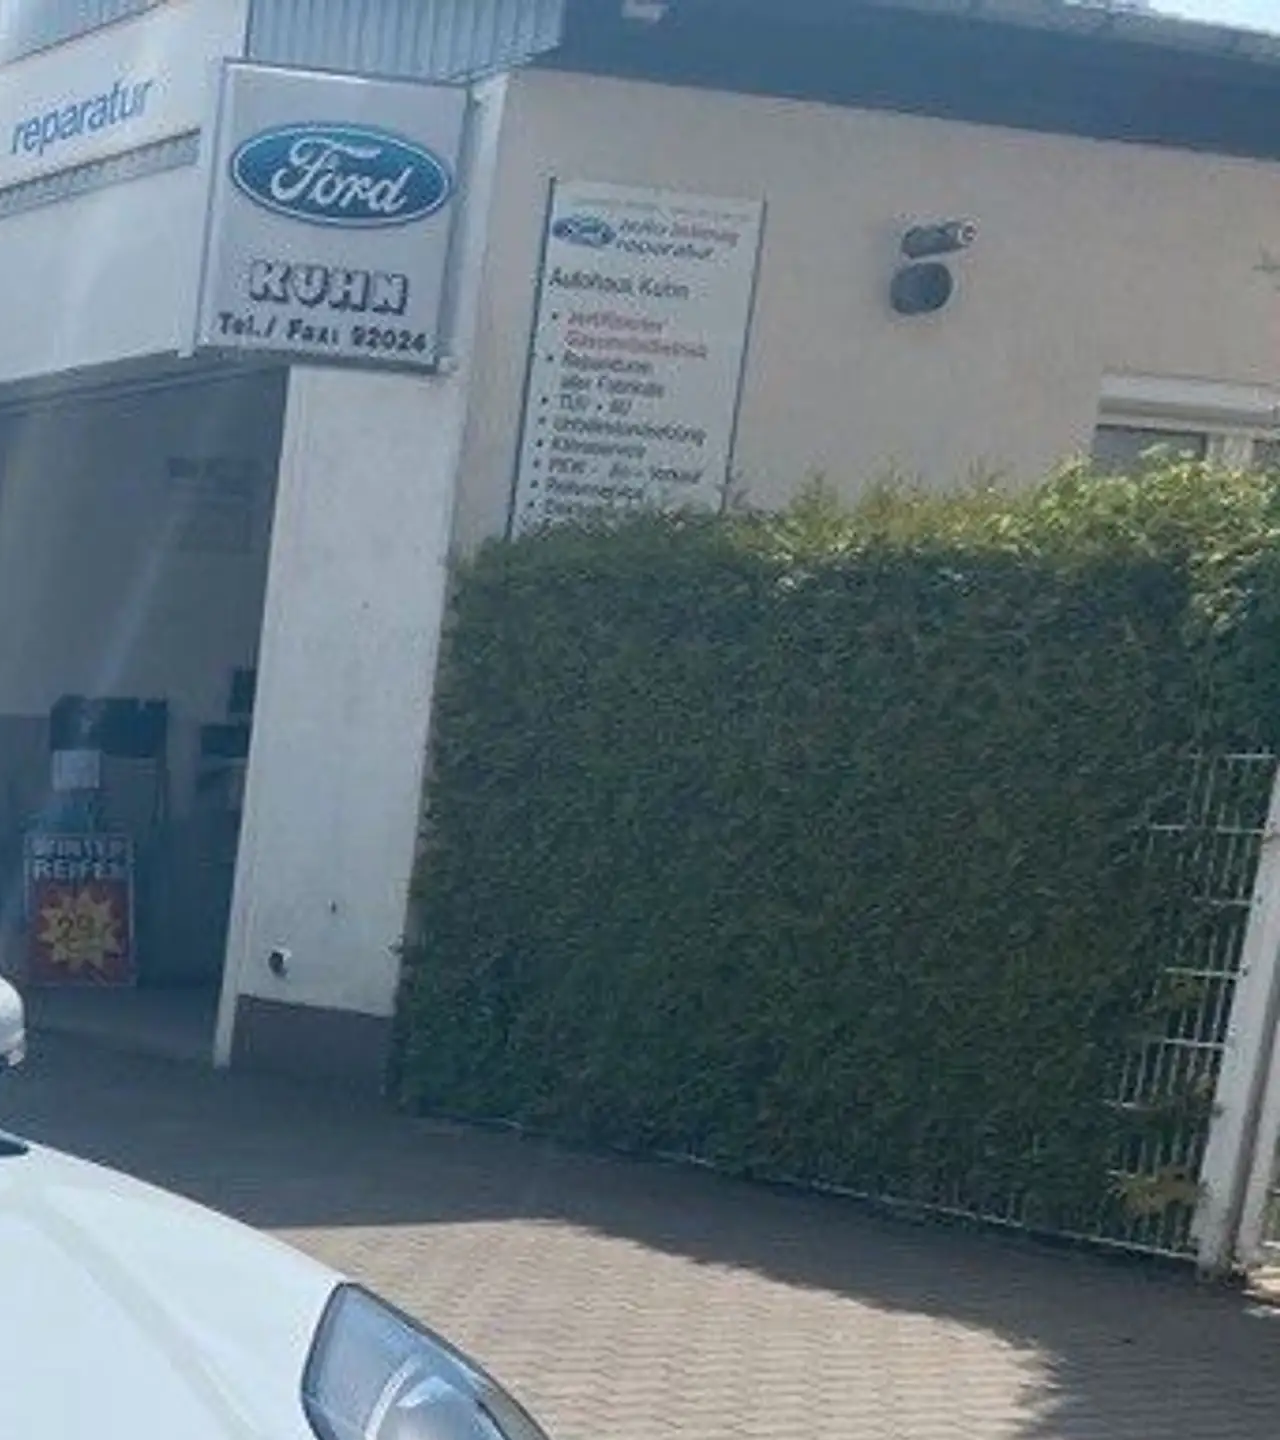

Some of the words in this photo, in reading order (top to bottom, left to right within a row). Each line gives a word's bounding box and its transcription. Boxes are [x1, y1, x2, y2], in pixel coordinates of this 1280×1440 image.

[11, 80, 153, 157] reparatur
[269, 136, 416, 215] Ford
[248, 259, 410, 316] KUHN
[350, 325, 430, 353] 92024
